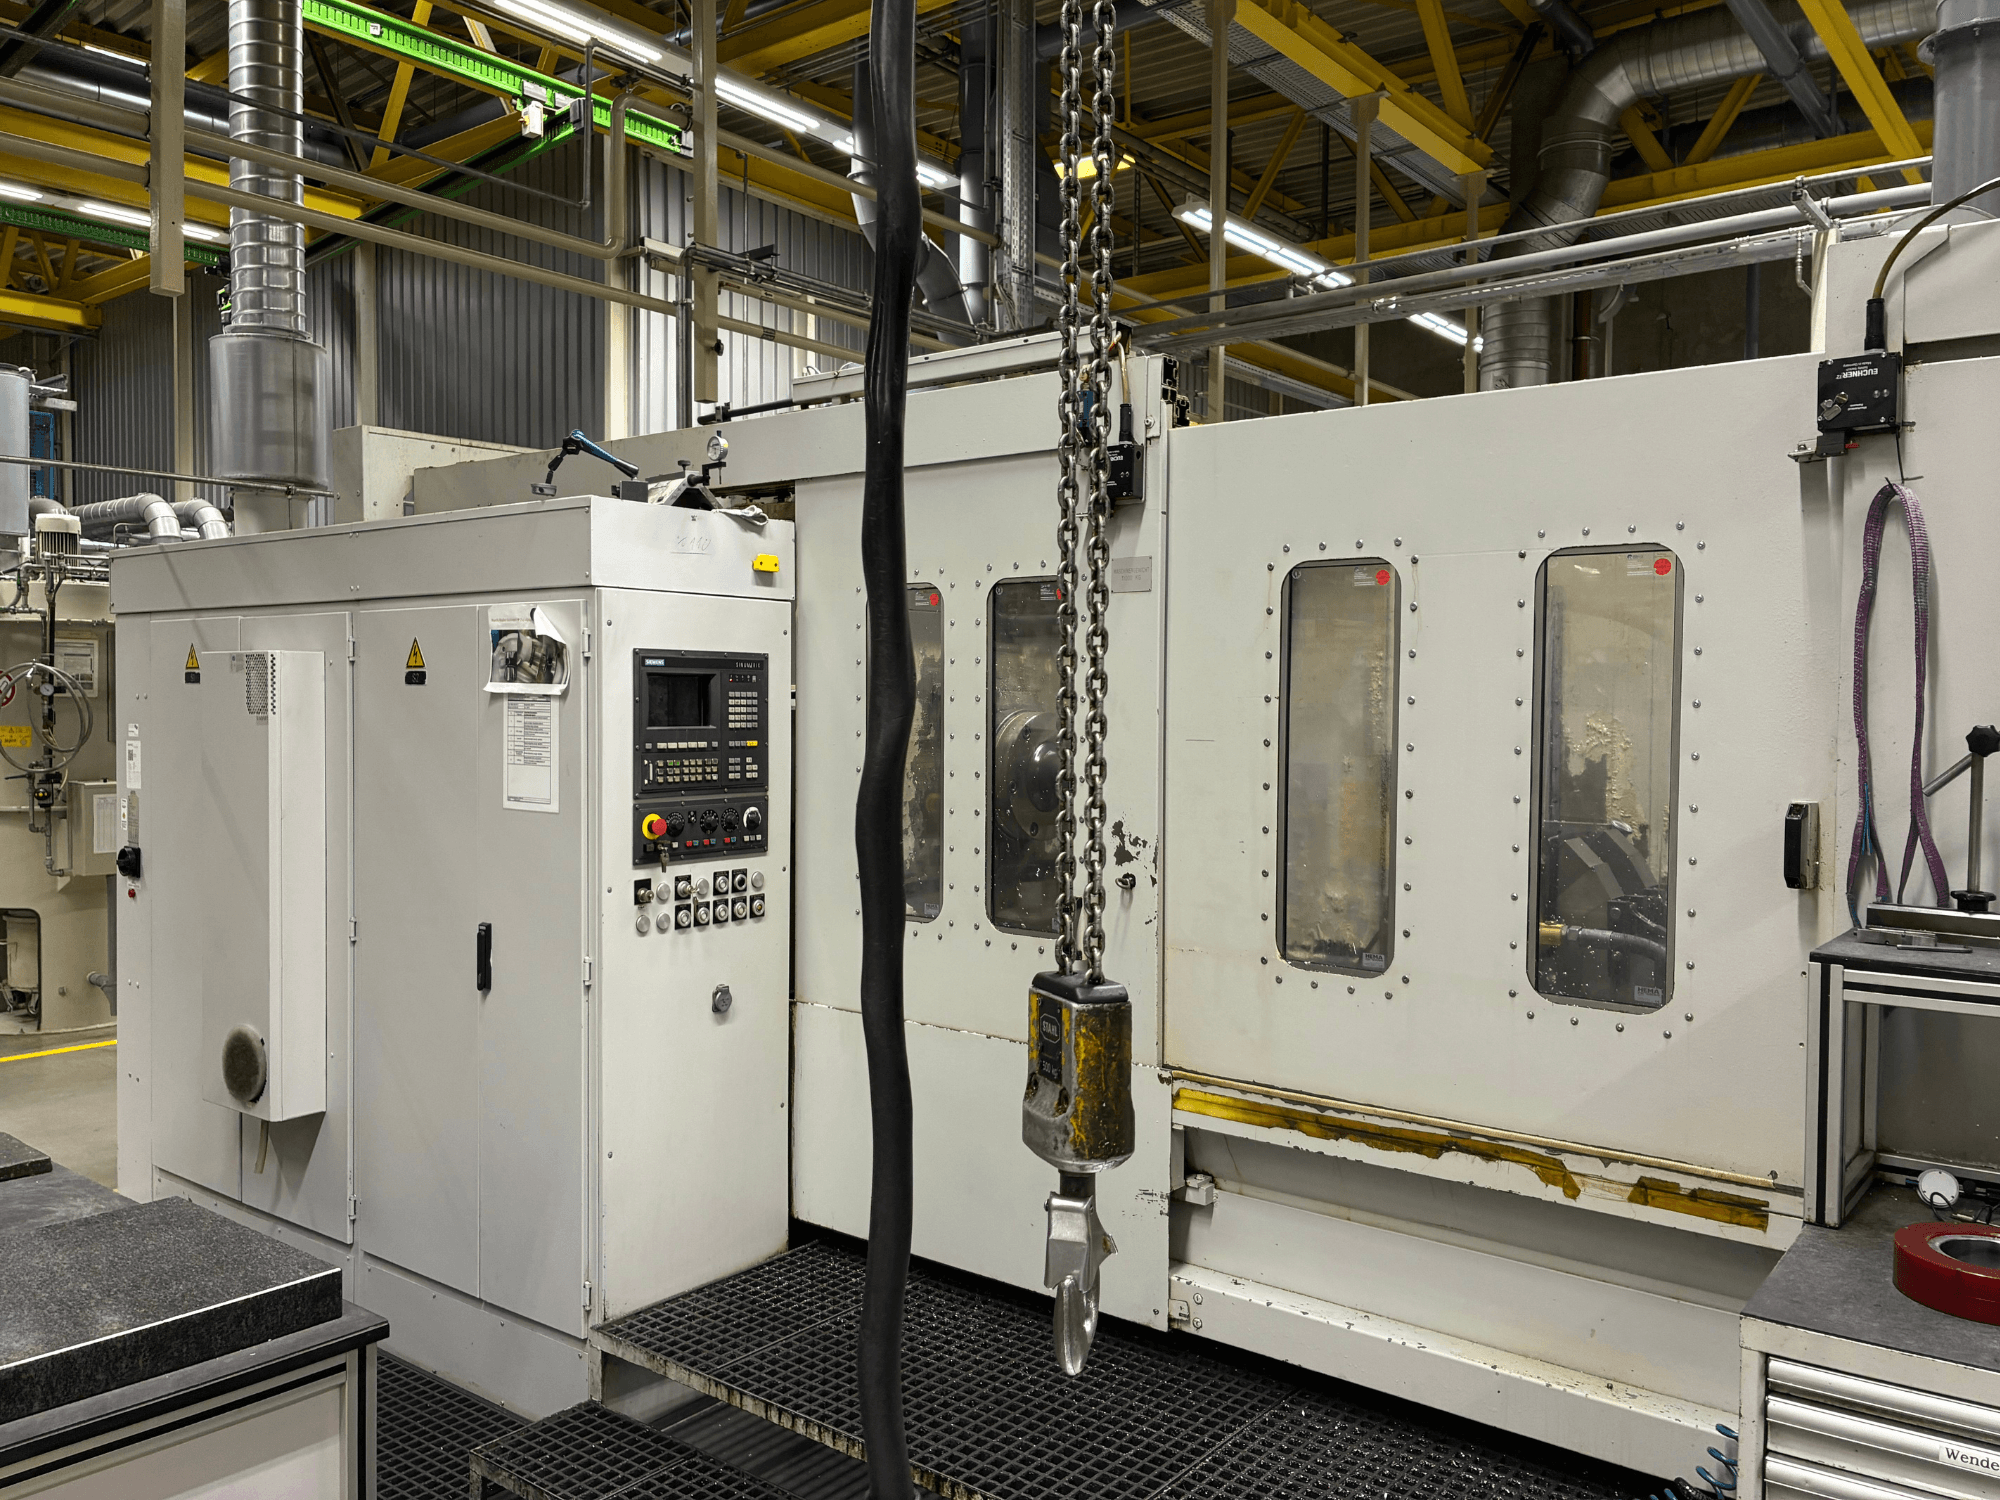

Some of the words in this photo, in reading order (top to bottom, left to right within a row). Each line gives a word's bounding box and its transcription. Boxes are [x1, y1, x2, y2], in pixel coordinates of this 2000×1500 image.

[1842, 367, 1879, 379] EUCHNER
[1637, 986, 1660, 995] HEMA
[1042, 1020, 1058, 1037] STAHL
[1042, 1060, 1051, 1073] 500
[1051, 1065, 1059, 1079] kg
[1945, 1446, 2000, 1471] Wende
